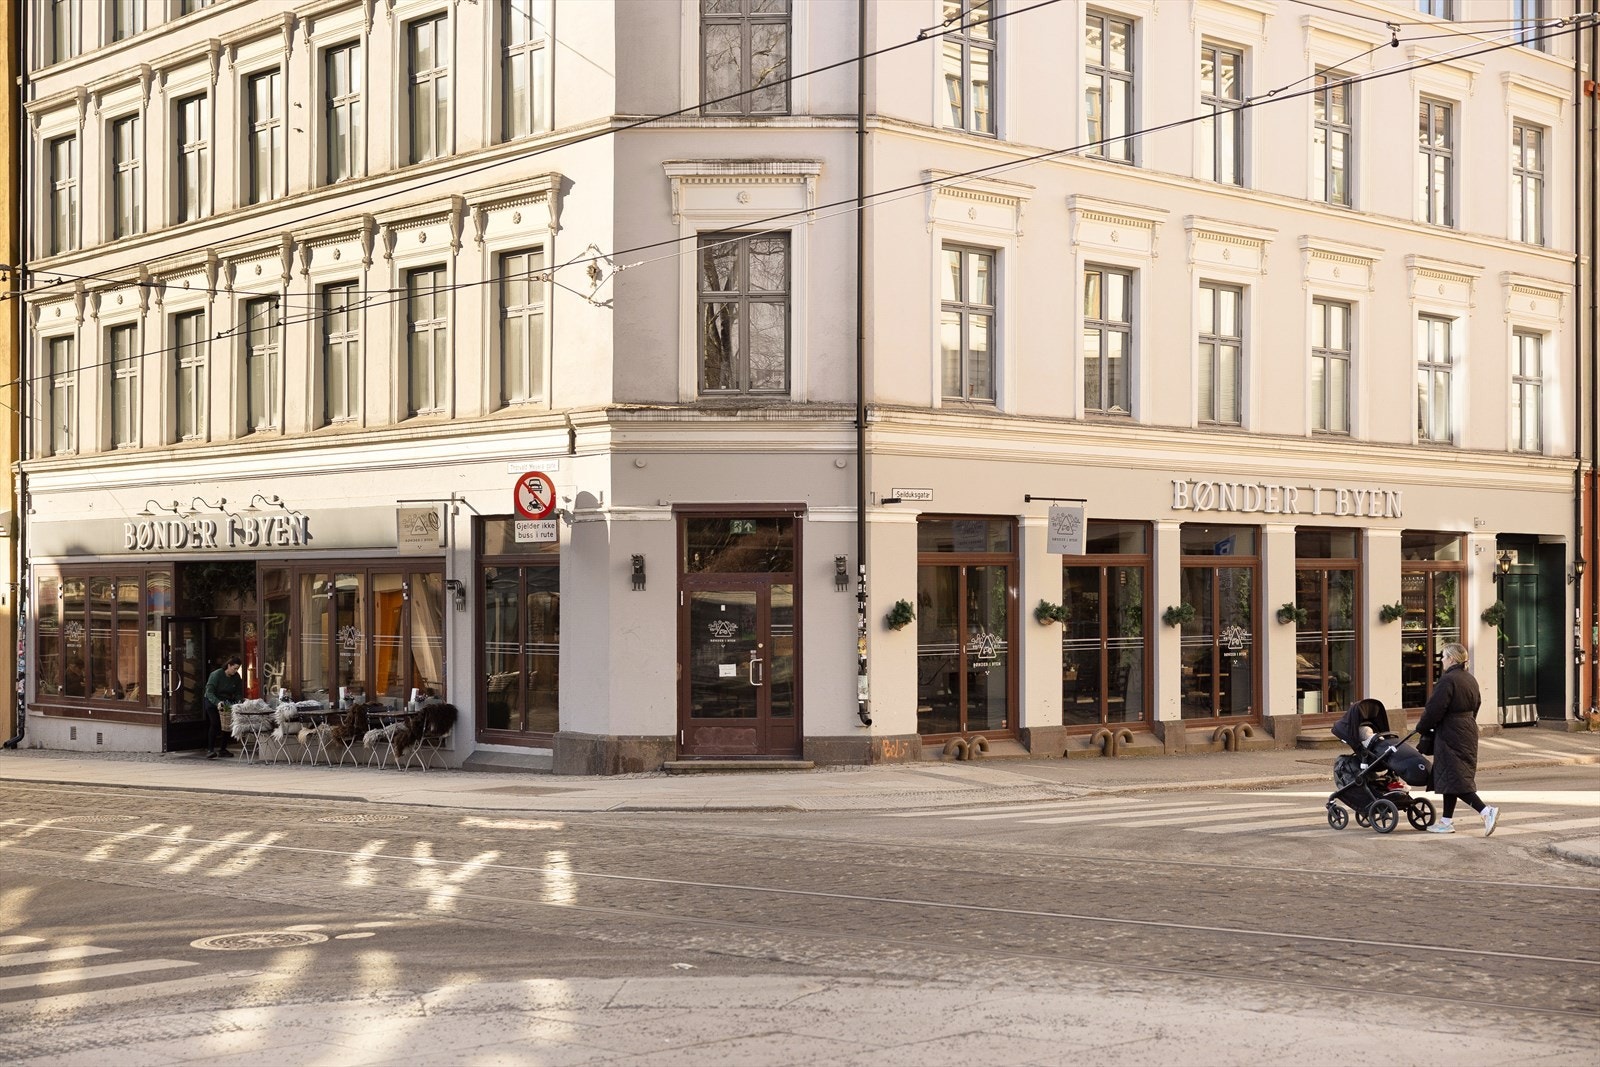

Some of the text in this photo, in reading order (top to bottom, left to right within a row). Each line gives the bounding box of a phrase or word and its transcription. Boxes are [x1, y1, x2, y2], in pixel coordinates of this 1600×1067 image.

[1171, 480, 1404, 519] BØNDER I BYEN
[124, 514, 308, 549] BØNDER I BYEN
[516, 523, 540, 531] Gjelder
